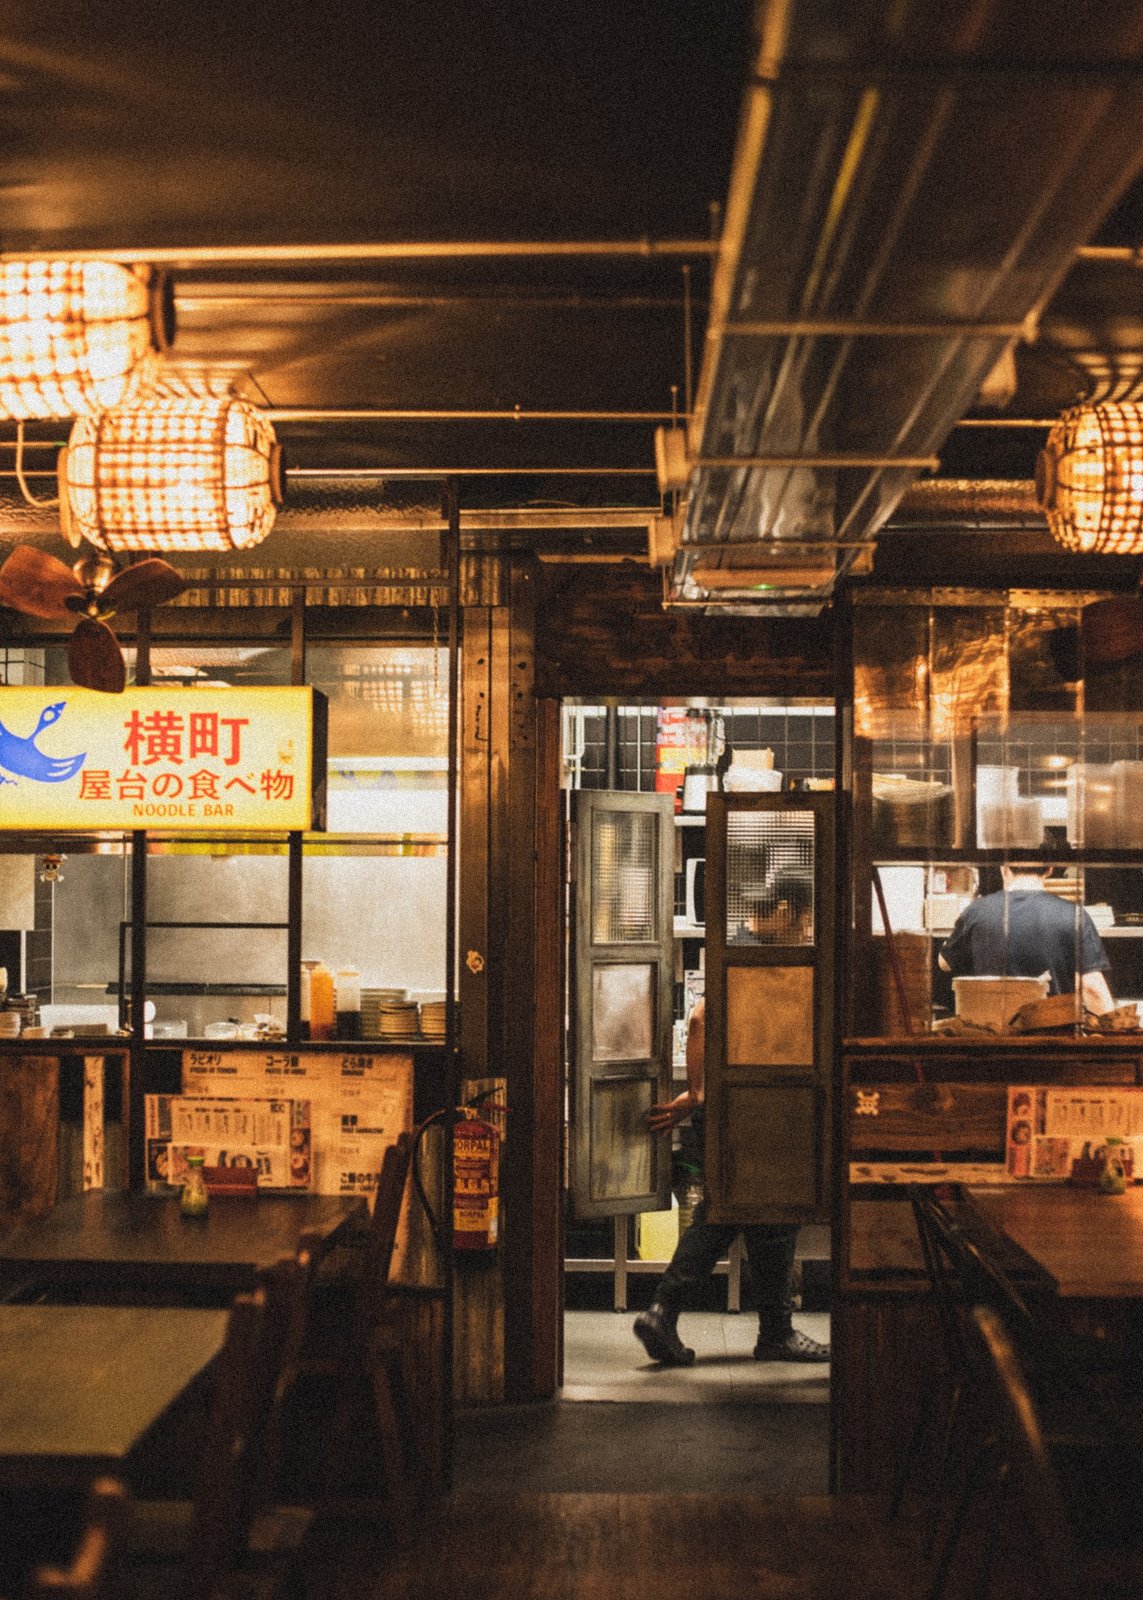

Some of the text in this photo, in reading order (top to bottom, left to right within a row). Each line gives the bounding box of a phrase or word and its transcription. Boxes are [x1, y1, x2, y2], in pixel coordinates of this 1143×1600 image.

[123, 709, 249, 766] 横町
[79, 769, 294, 801] 屋台の食べ物
[132, 803, 234, 817] NOODLE BAR
